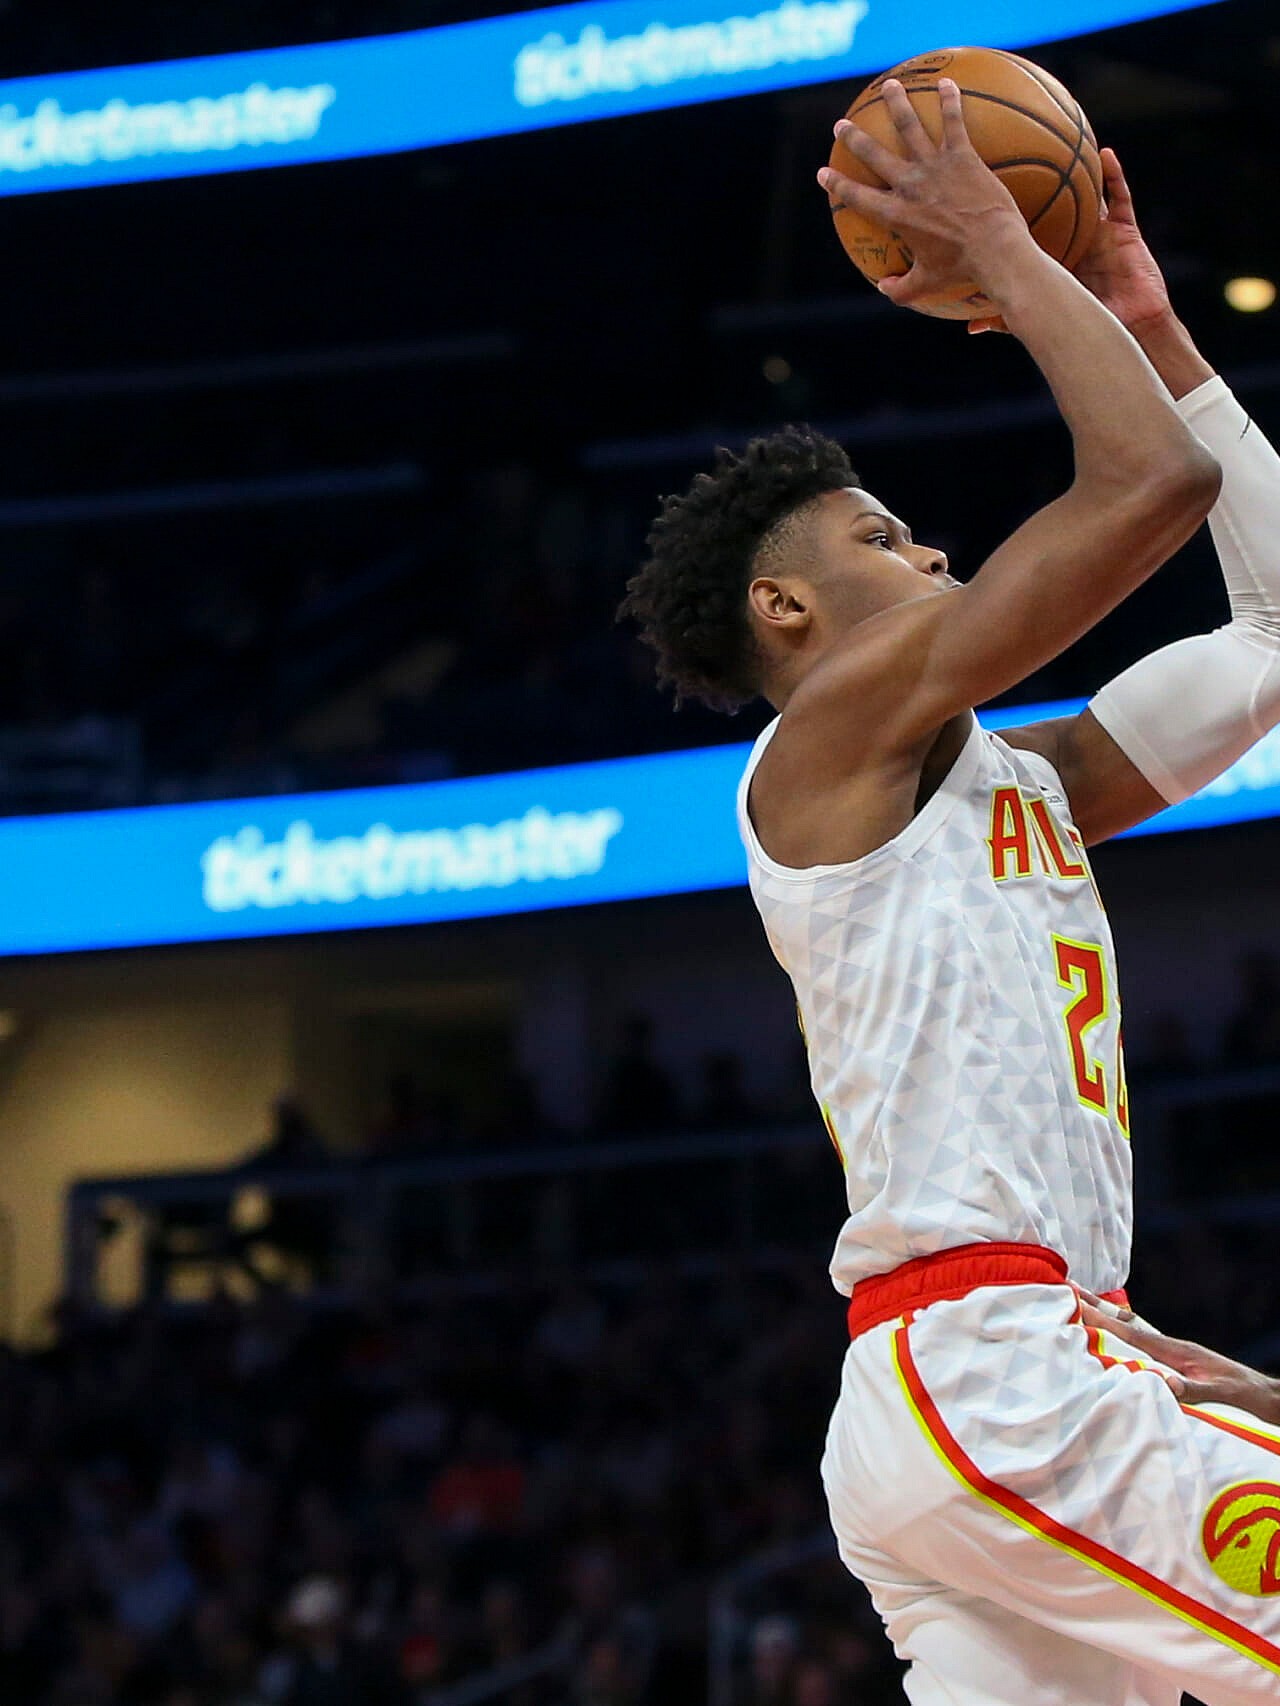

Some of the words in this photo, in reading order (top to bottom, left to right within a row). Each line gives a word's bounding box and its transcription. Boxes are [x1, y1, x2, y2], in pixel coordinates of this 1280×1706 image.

[514, 0, 868, 106] ticketmaster
[0, 84, 335, 171] icketmaster
[201, 806, 622, 912] ticketmaster
